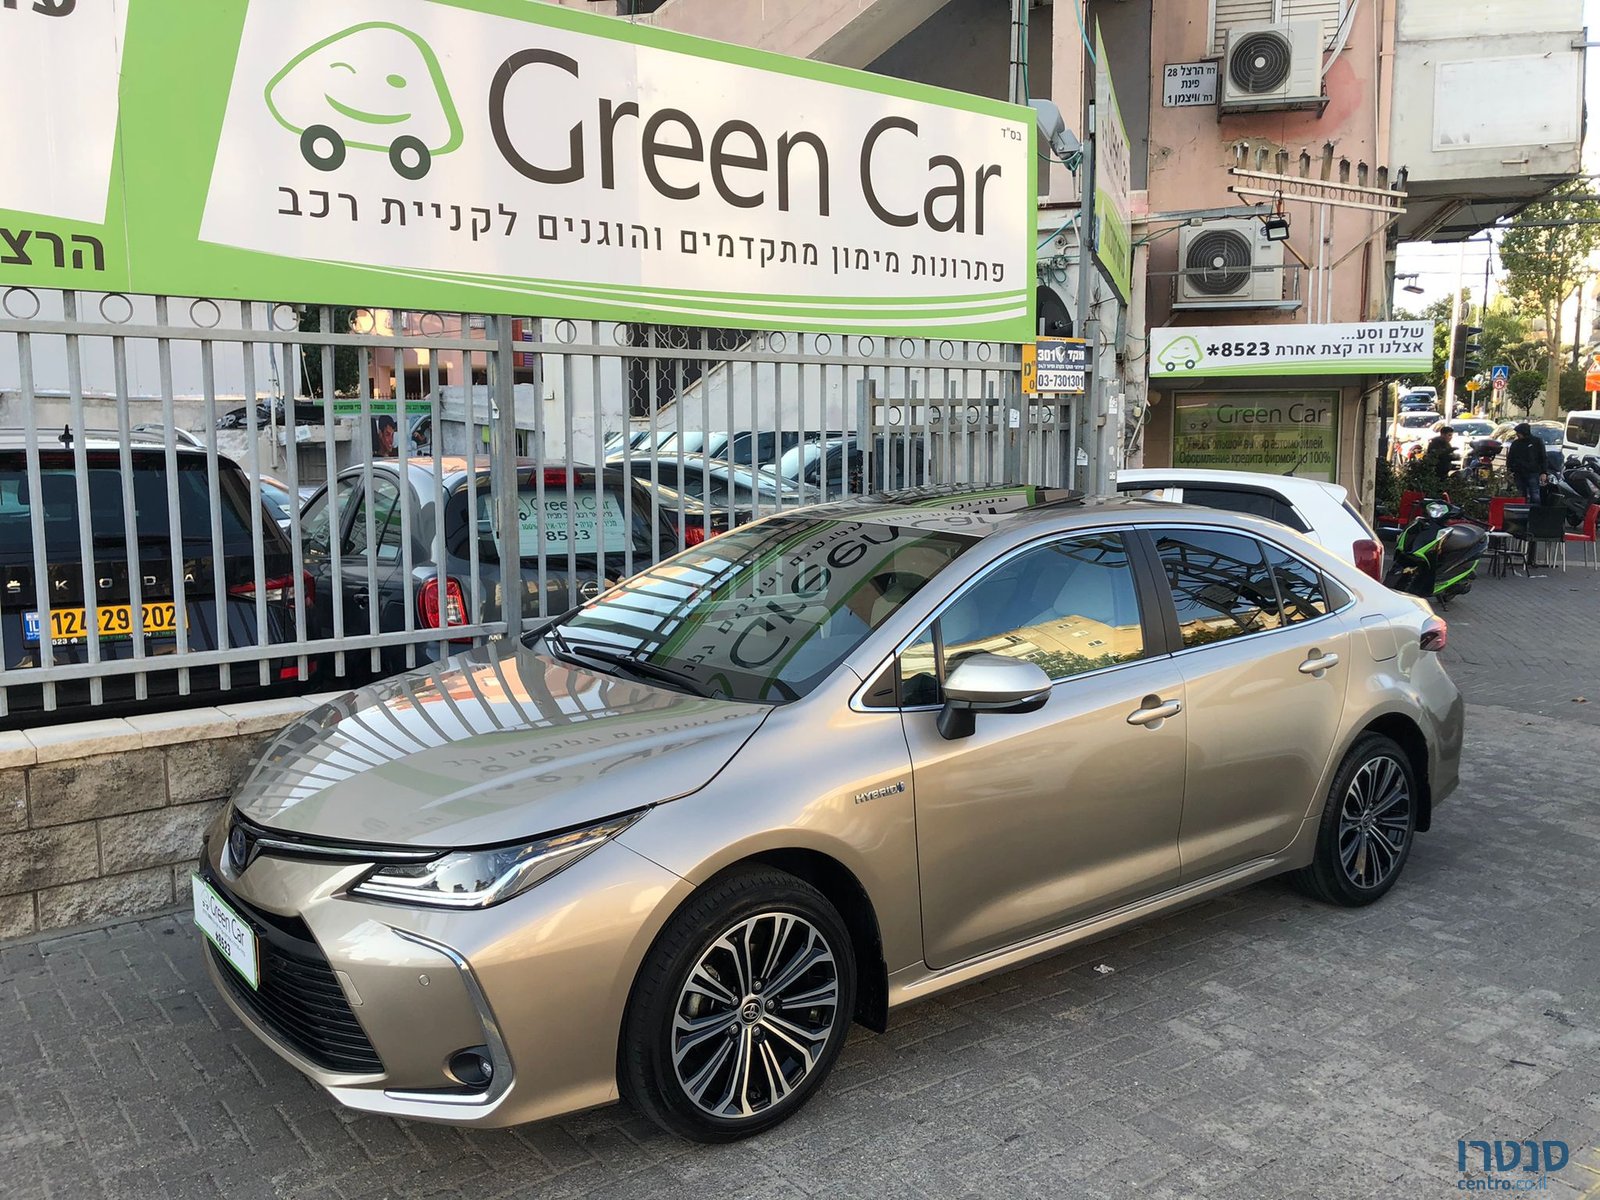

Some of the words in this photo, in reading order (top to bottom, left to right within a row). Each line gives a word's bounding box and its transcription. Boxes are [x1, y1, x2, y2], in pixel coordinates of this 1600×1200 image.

[1167, 68, 1178, 77] 28
[1180, 65, 1204, 76] הרצל
[1181, 79, 1200, 89] פינת
[1167, 95, 1172, 103] 1
[1000, 127, 1022, 141] בס"ד
[488, 47, 831, 217] Green
[859, 115, 1002, 236] Car
[278, 186, 360, 221] רכב
[380, 197, 518, 241] לקניית
[538, 213, 663, 252] והוגנים
[680, 230, 819, 269] מתקדמים
[832, 244, 901, 275] מימון
[911, 253, 1005, 284] פתרונות
[1388, 326, 1424, 339] שלם
[1275, 344, 1317, 356] אחרת
[1320, 343, 1353, 357] קצת
[1358, 342, 1375, 354] זה
[1380, 340, 1424, 354] אצלנו
[1037, 349, 1056, 361] 301
[1038, 374, 1085, 387] 03-7301301
[1217, 404, 1282, 423] Green
[1288, 403, 1327, 423] Car
[1310, 451, 1331, 464] 100%
[582, 496, 609, 510] Cr
[854, 785, 898, 804] HYBRID
[211, 895, 232, 932] Green
[232, 918, 245, 946] Car
